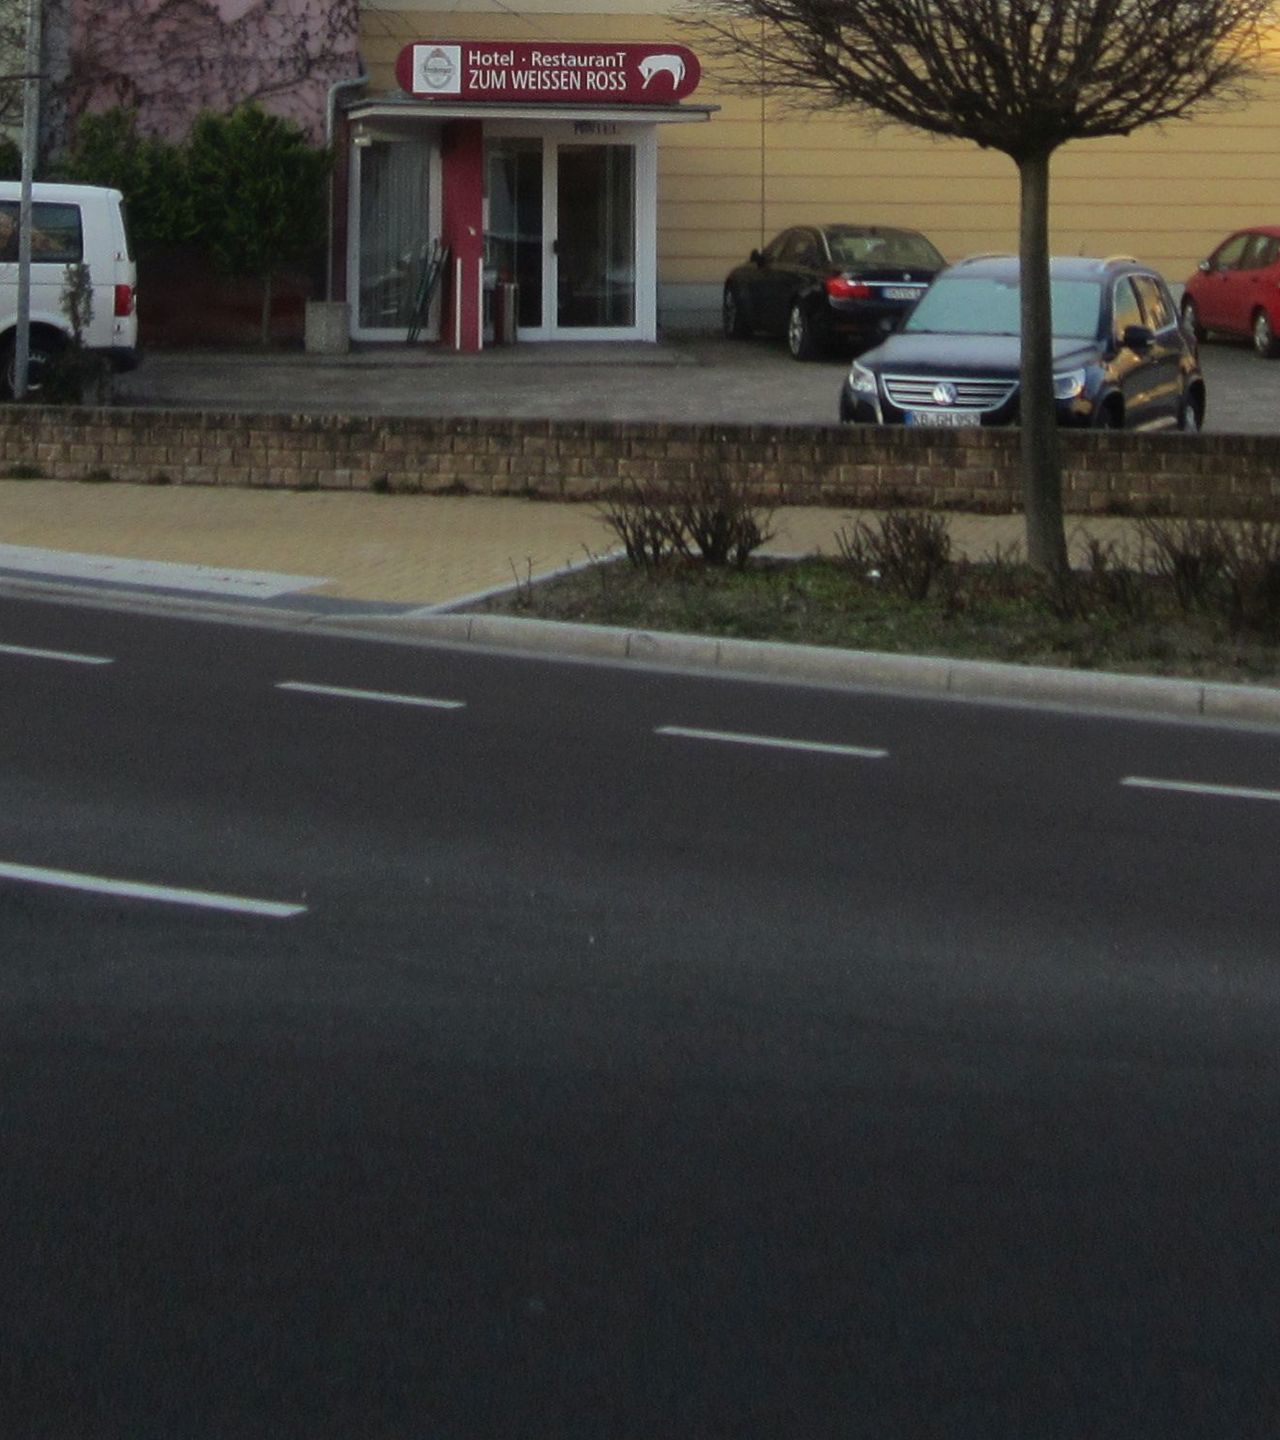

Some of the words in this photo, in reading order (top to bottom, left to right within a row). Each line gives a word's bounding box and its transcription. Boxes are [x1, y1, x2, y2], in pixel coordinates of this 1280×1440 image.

[469, 50, 514, 66] Hotel
[469, 70, 506, 89] ZUM
[511, 70, 581, 90] WEISSEN
[586, 71, 627, 91] ROSS
